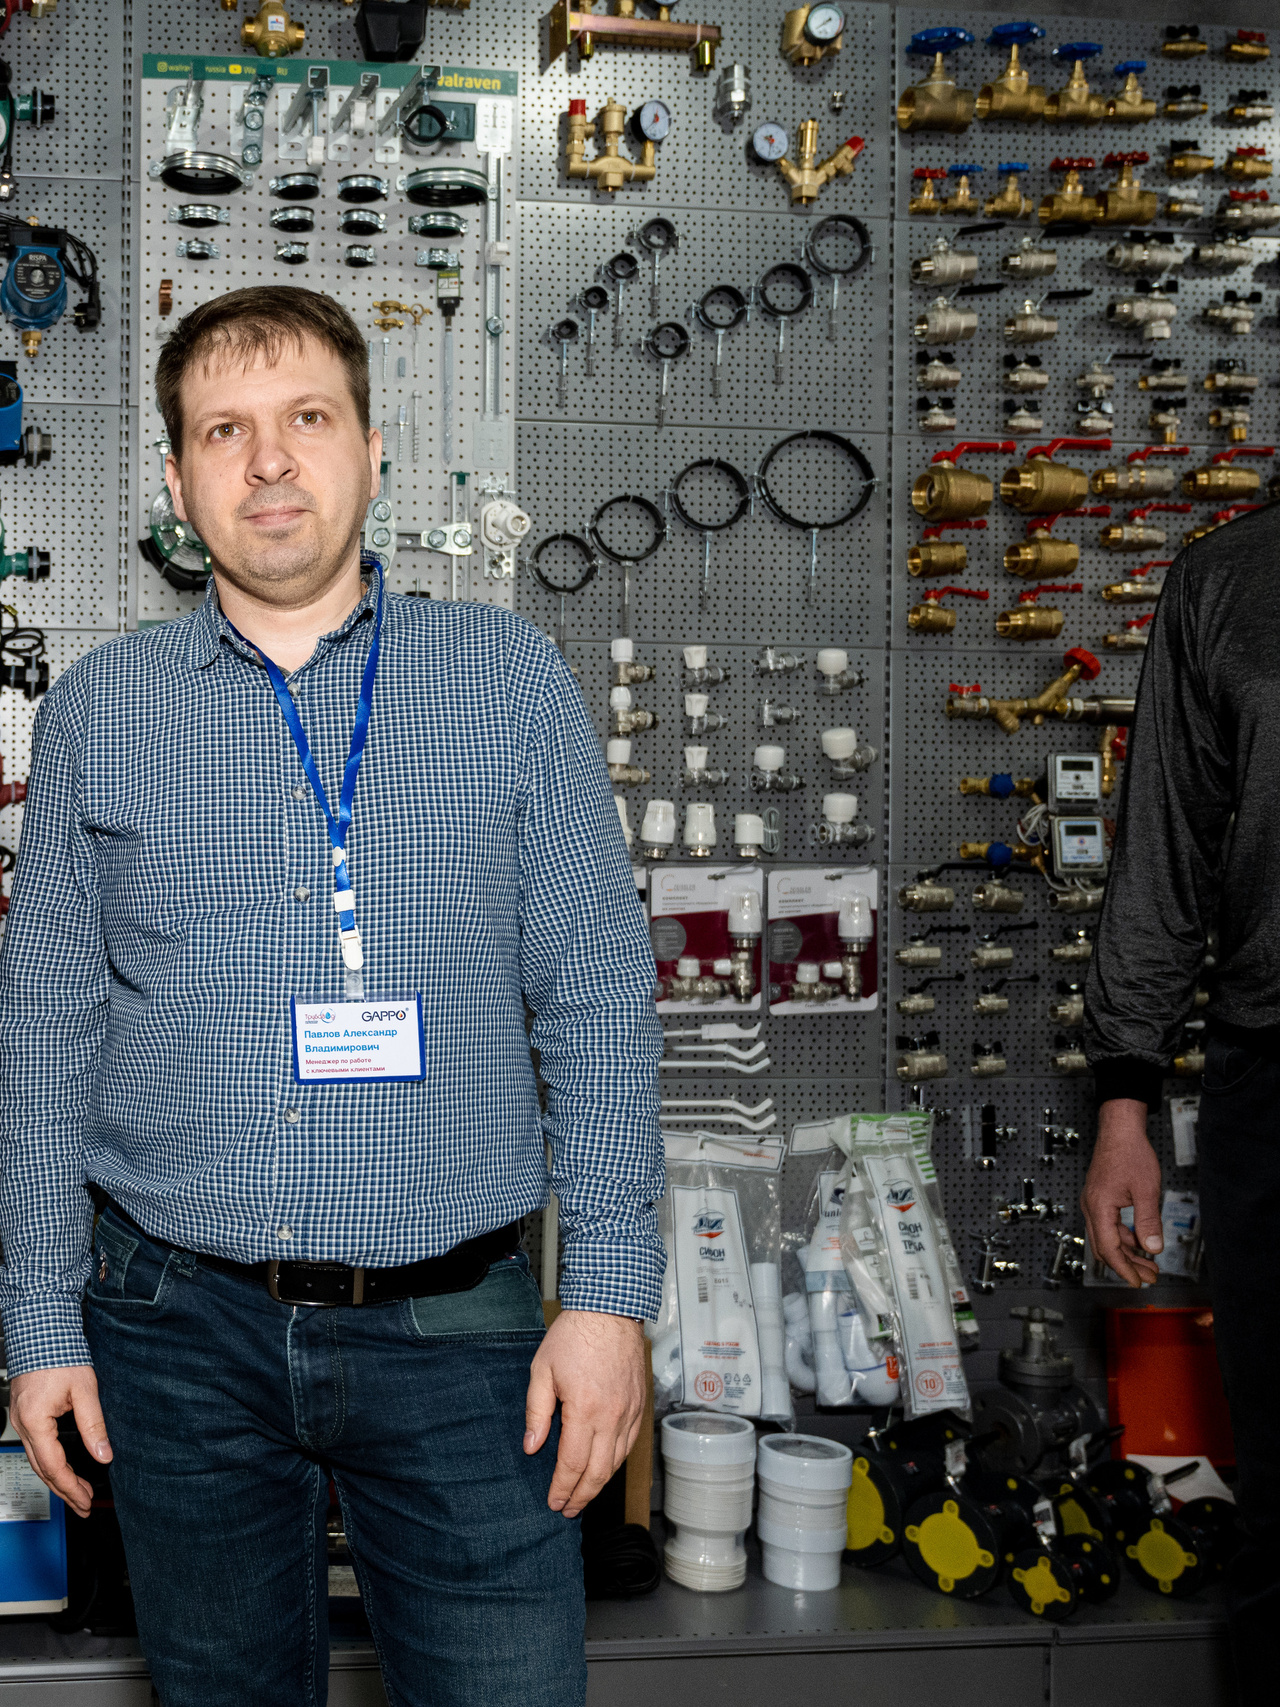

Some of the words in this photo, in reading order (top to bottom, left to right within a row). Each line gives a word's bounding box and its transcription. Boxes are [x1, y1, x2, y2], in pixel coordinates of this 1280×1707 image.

[361, 1010, 406, 1022] GAPPO
[304, 1030, 341, 1039] Павлов
[343, 1028, 398, 1039] Александр
[304, 1043, 380, 1054] Владимирович
[305, 1058, 339, 1066] Менеджер
[349, 1057, 372, 1065] работе
[350, 1065, 386, 1073] клиентами
[702, 1380, 716, 1393] 10
[924, 1378, 936, 1390] 10
